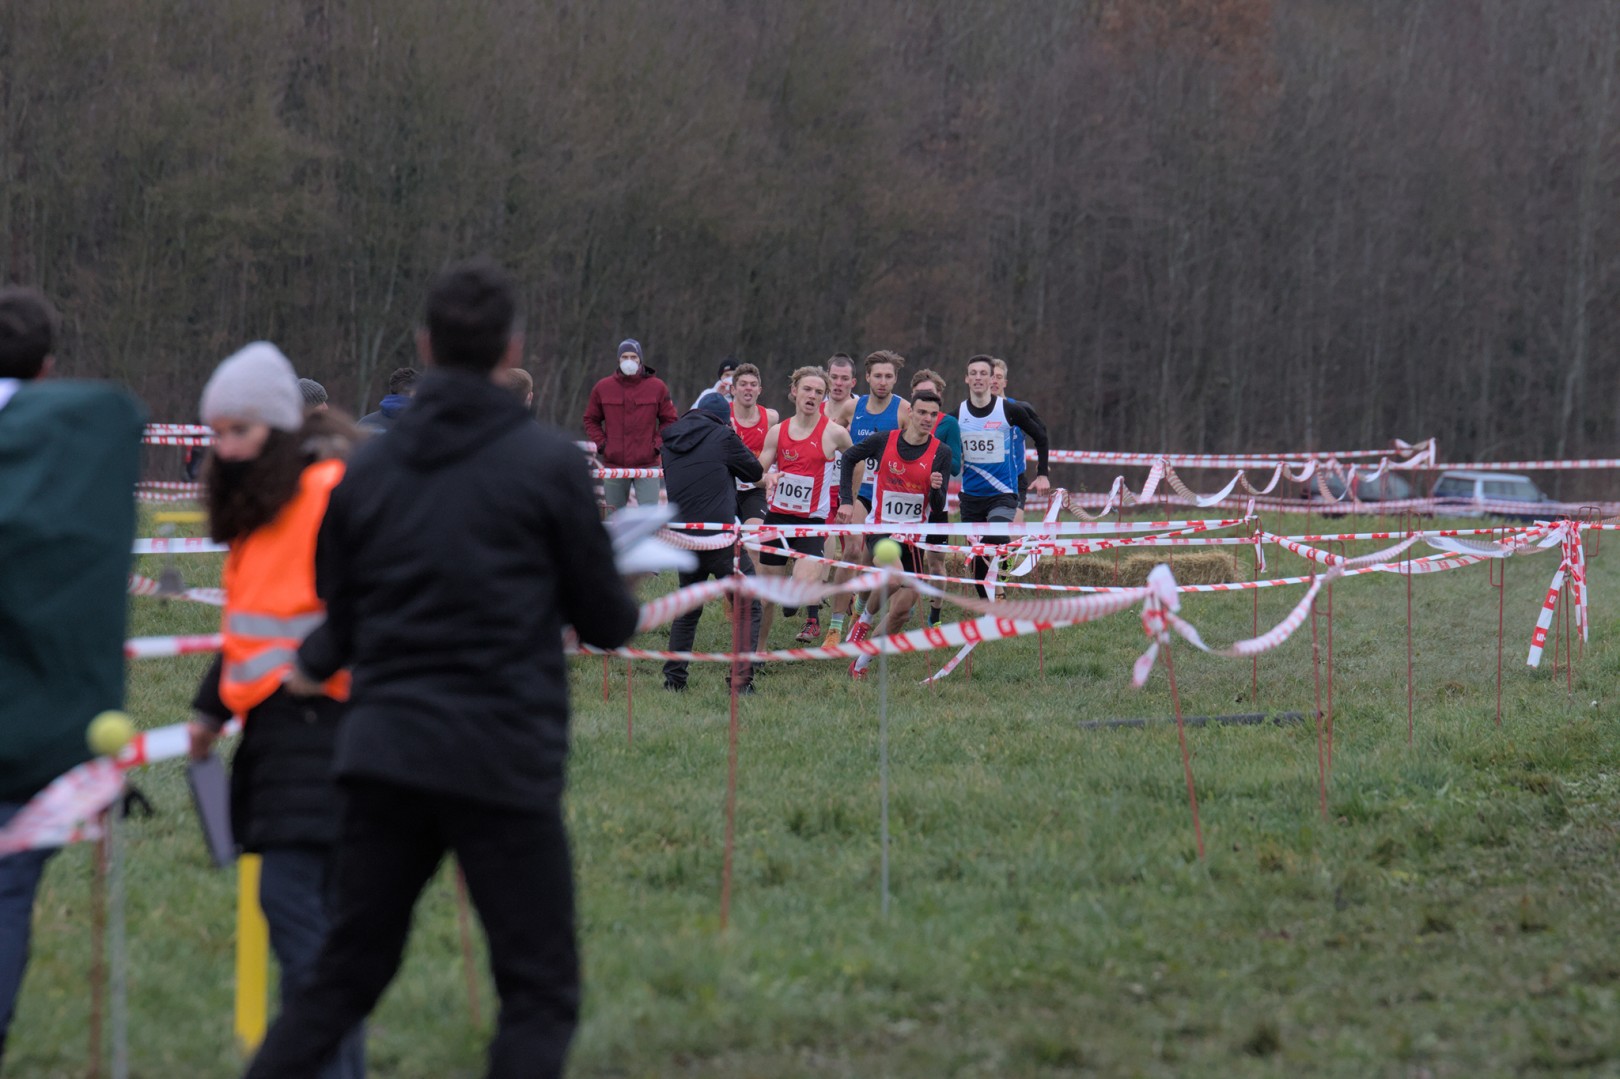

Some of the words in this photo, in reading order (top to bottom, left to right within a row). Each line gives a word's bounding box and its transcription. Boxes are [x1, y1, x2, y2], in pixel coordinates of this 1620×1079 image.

[963, 440, 994, 452] 1365
[779, 482, 812, 499] 1067
[885, 501, 922, 515] 1078
